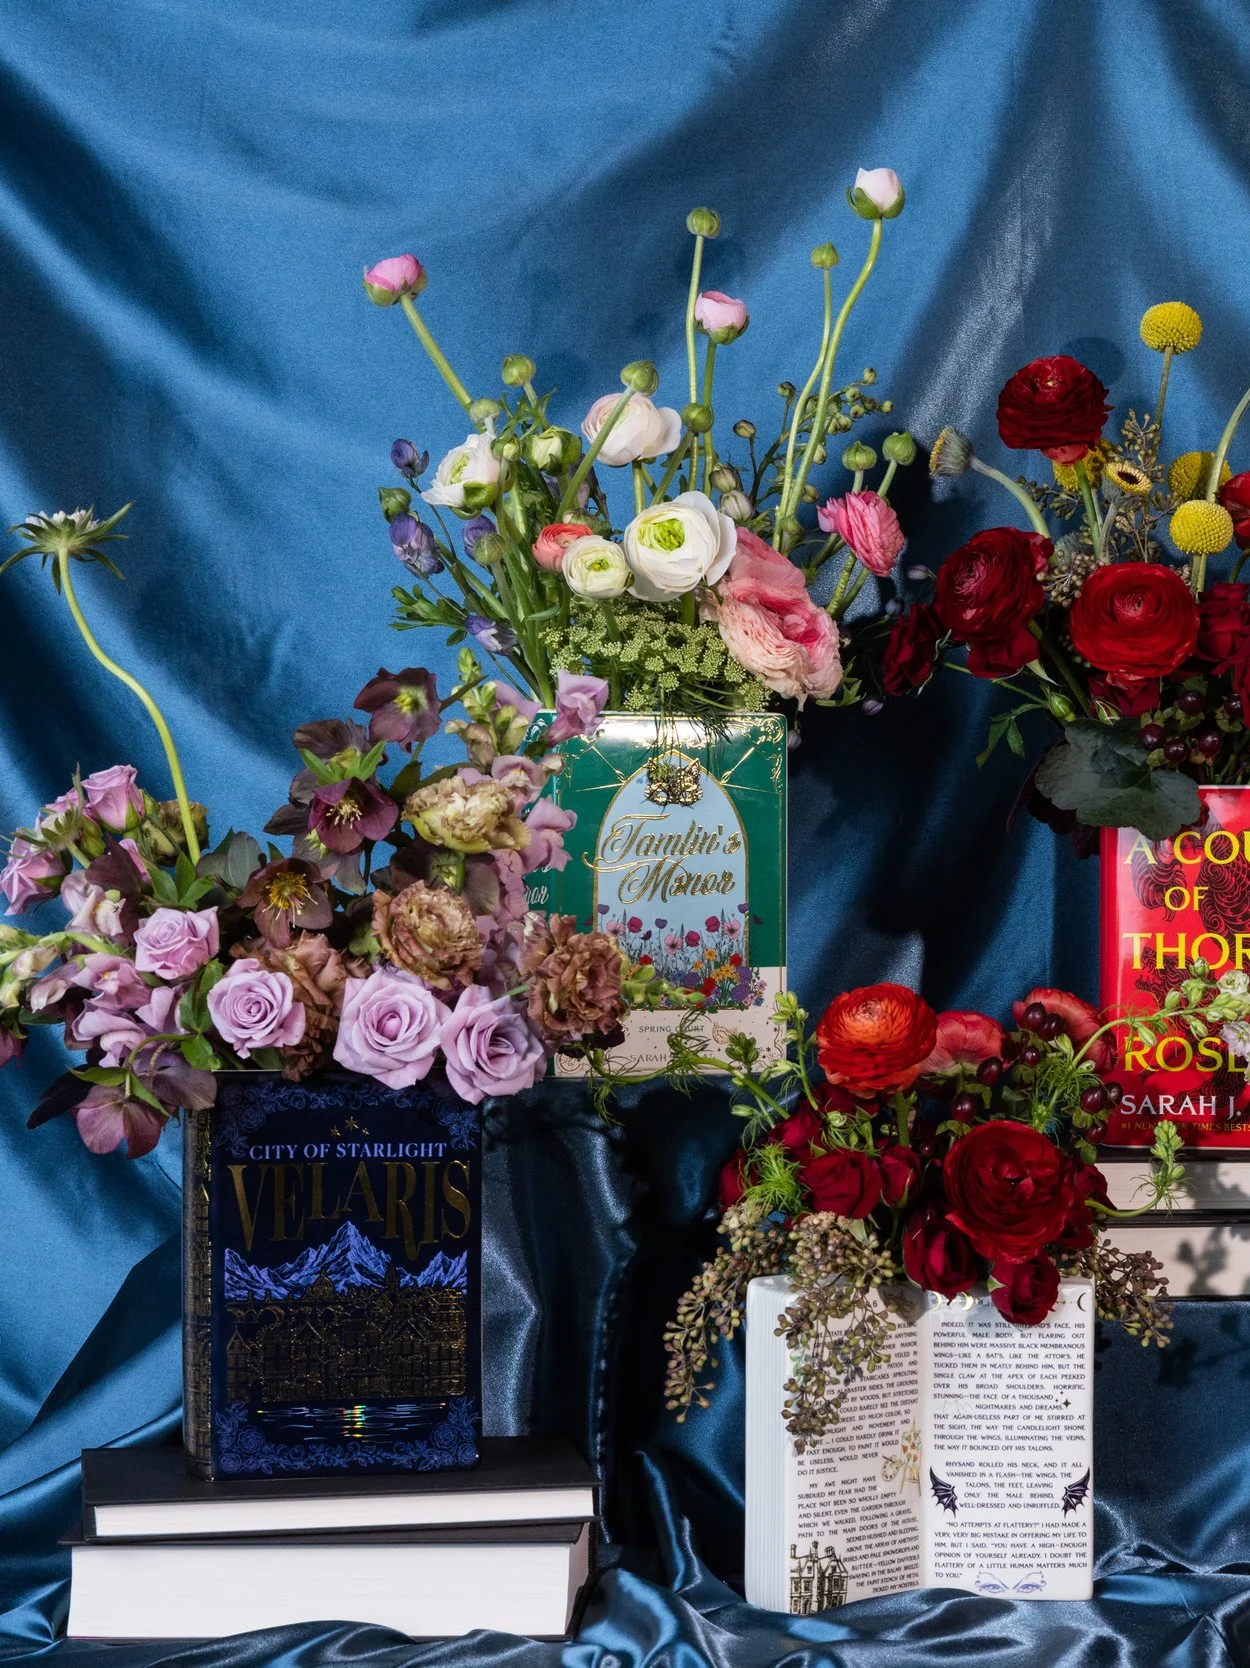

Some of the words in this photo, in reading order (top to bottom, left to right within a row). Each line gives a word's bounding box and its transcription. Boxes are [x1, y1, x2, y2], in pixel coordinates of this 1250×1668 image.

[601, 813, 742, 864] Tamlin's
[1124, 833, 1158, 864] A
[584, 854, 736, 904] Manor
[1164, 887, 1208, 910] OF
[1120, 1095, 1216, 1116] SARAH
[1228, 1096, 1242, 1120] J.
[1192, 1123, 1220, 1131] TIMES
[250, 1144, 298, 1160] CITY
[304, 1144, 330, 1158] OF
[336, 1143, 447, 1157] STARLIGHT
[227, 1160, 471, 1260] VELARIS
